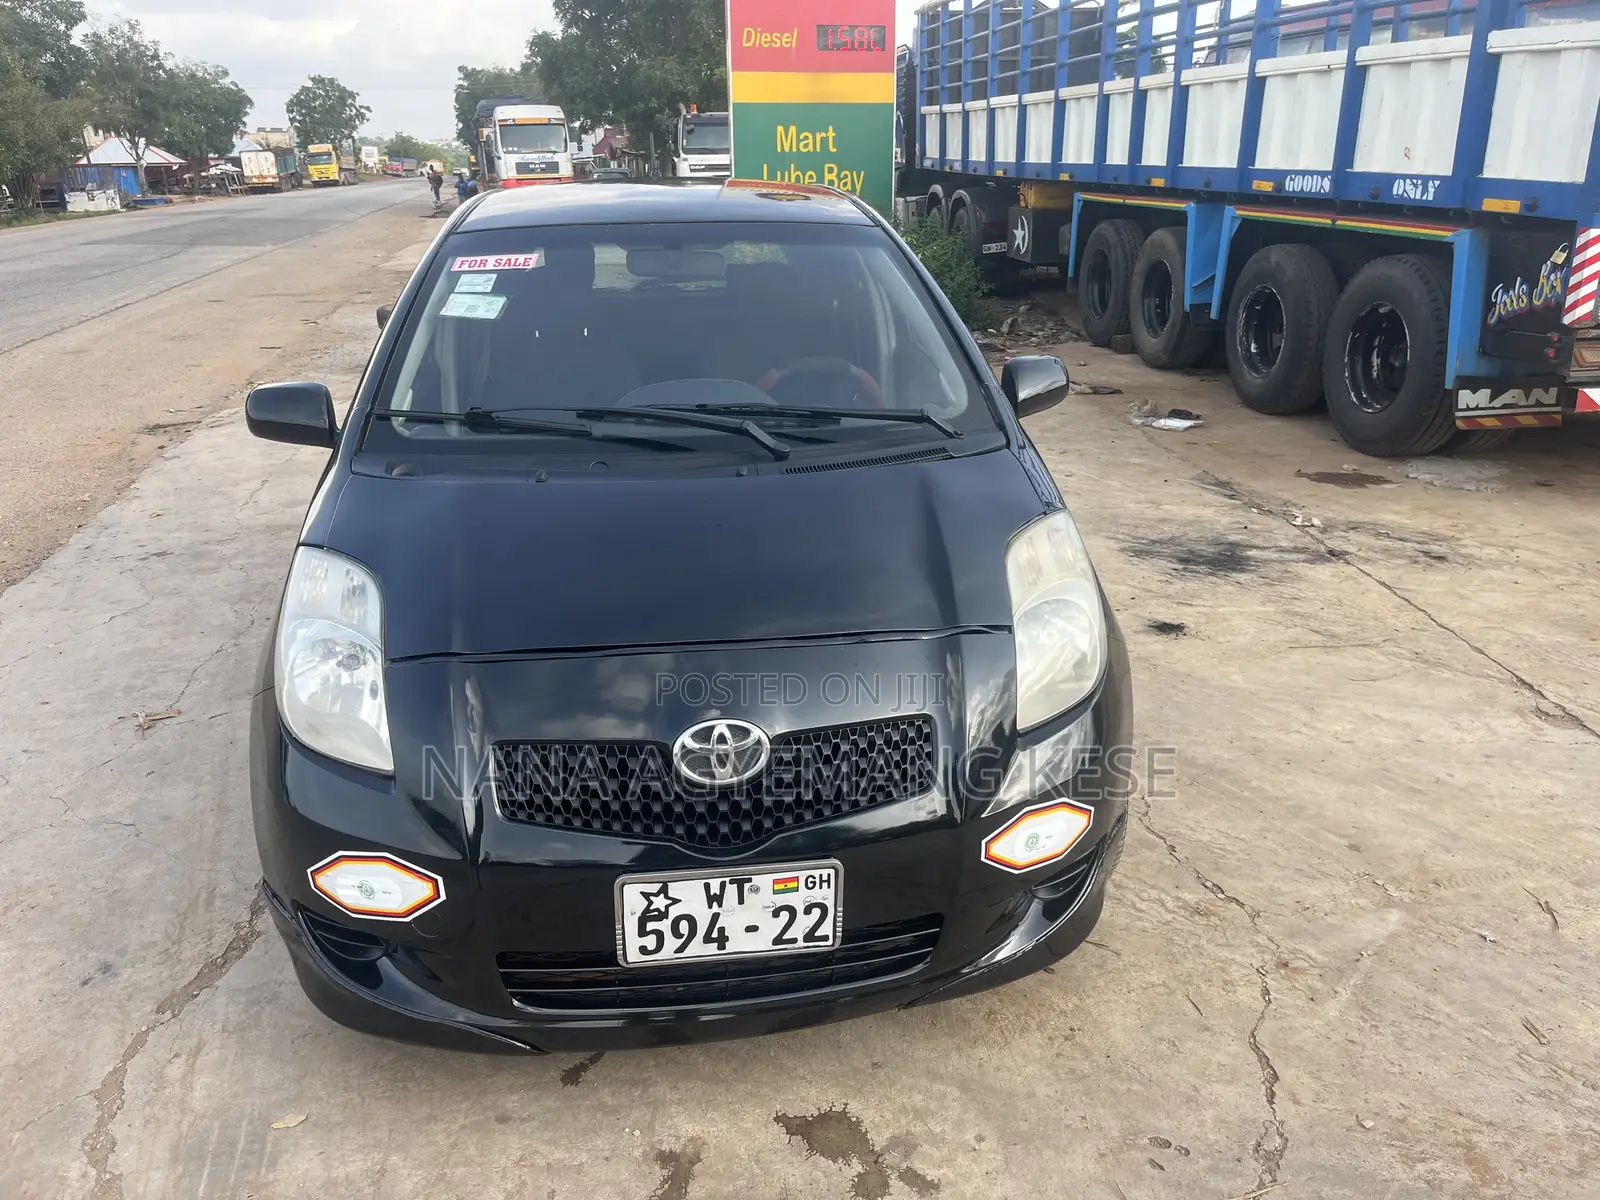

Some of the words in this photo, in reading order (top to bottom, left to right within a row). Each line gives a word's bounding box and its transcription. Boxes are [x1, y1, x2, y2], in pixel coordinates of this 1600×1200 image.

[742, 28, 798, 48] Diesel
[776, 125, 837, 153] Mart
[824, 163, 865, 196] Bay
[1285, 174, 1332, 194] GOODS
[1392, 178, 1441, 201] ONLY
[457, 258, 489, 269] FOR
[492, 257, 533, 268] SALE
[1457, 387, 1559, 409] MAN
[703, 877, 753, 910] WT
[804, 872, 832, 891] GH
